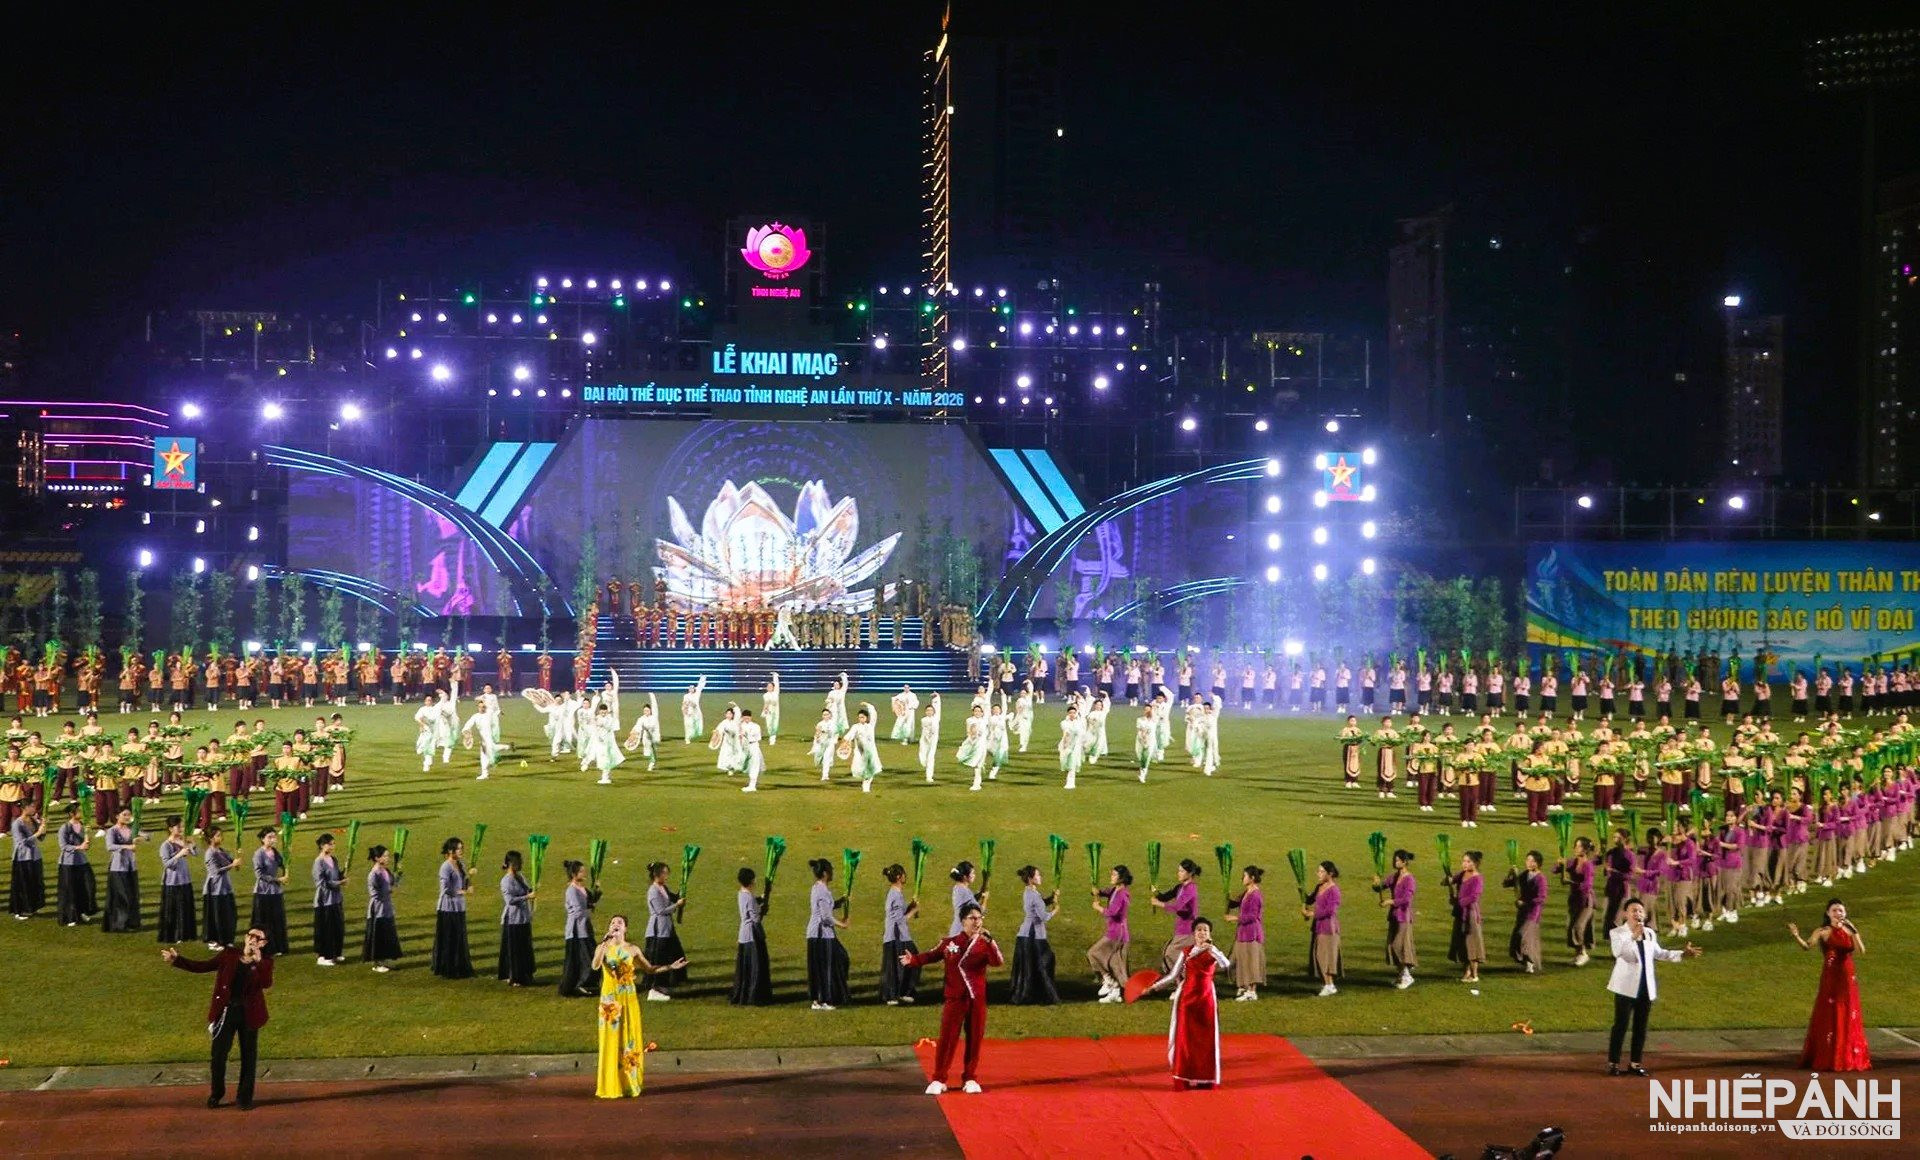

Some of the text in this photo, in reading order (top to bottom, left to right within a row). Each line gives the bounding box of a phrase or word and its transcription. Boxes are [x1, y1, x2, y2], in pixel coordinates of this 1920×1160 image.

[751, 285, 801, 299] TỈNH NGHỆ AN
[713, 343, 838, 380] LỄ KHAI MẠC
[584, 386, 605, 404] ĐẠI
[607, 384, 629, 405] HỘI
[631, 381, 655, 402] THỂ
[656, 387, 682, 405] DỤC
[684, 382, 708, 403] THỂ
[710, 388, 742, 403] THAO
[744, 384, 773, 403] TỈNH
[775, 386, 808, 407] NGHỆ
[810, 390, 830, 404] AN
[831, 386, 855, 405] LẦN
[857, 388, 883, 405] THỨ
[883, 391, 893, 405] X
[903, 388, 932, 406] NĂM
[934, 393, 965, 406] 2026
[1602, 566, 1658, 592] TOÀN
[1664, 567, 1708, 593] DÂN
[1763, 566, 1831, 597] LUYỆN
[1837, 566, 1894, 593] THÂN
[1629, 608, 1680, 630] THEO
[1767, 605, 1808, 631] BÁC
[1850, 604, 1871, 631] VĨ
[1877, 609, 1914, 635] ĐẠI
